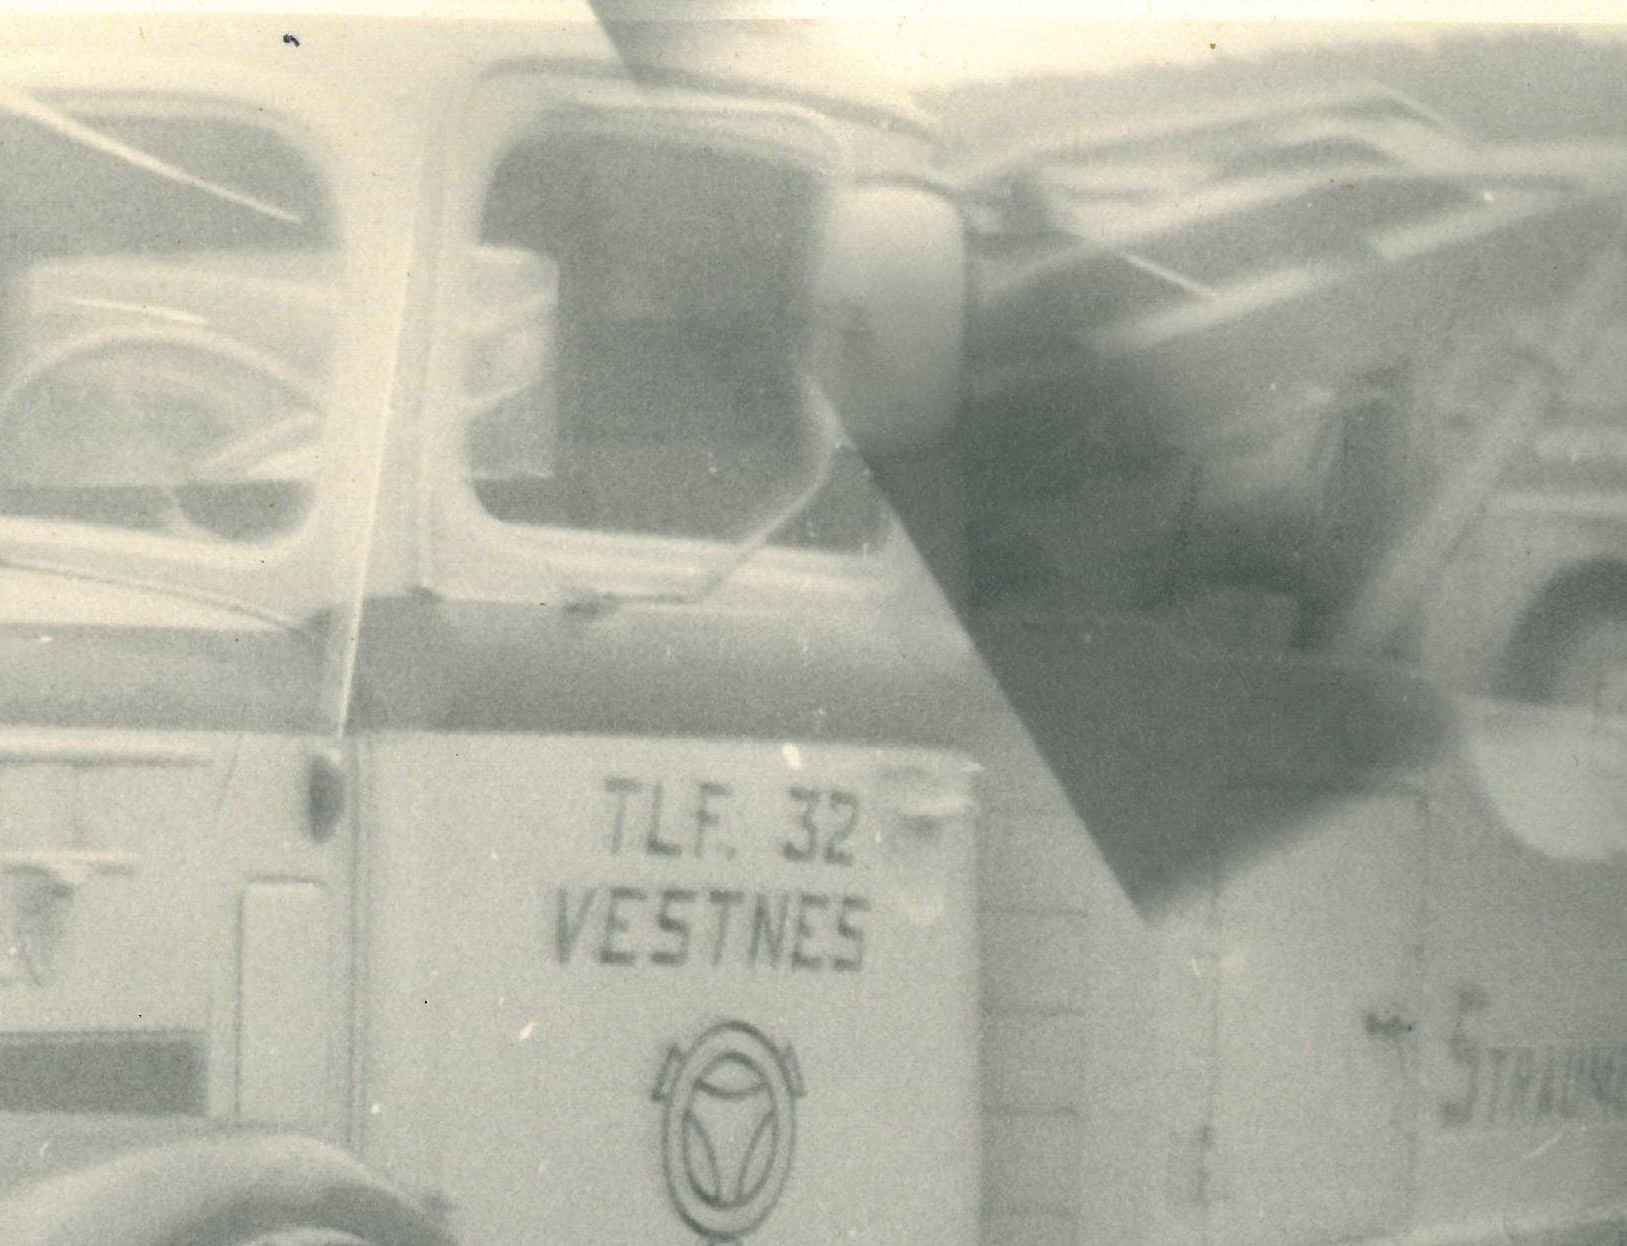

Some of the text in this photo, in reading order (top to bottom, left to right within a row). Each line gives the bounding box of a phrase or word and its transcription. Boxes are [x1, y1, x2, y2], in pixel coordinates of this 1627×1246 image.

[603, 775, 861, 867] TLF. 32
[551, 886, 875, 974] VESTNES
